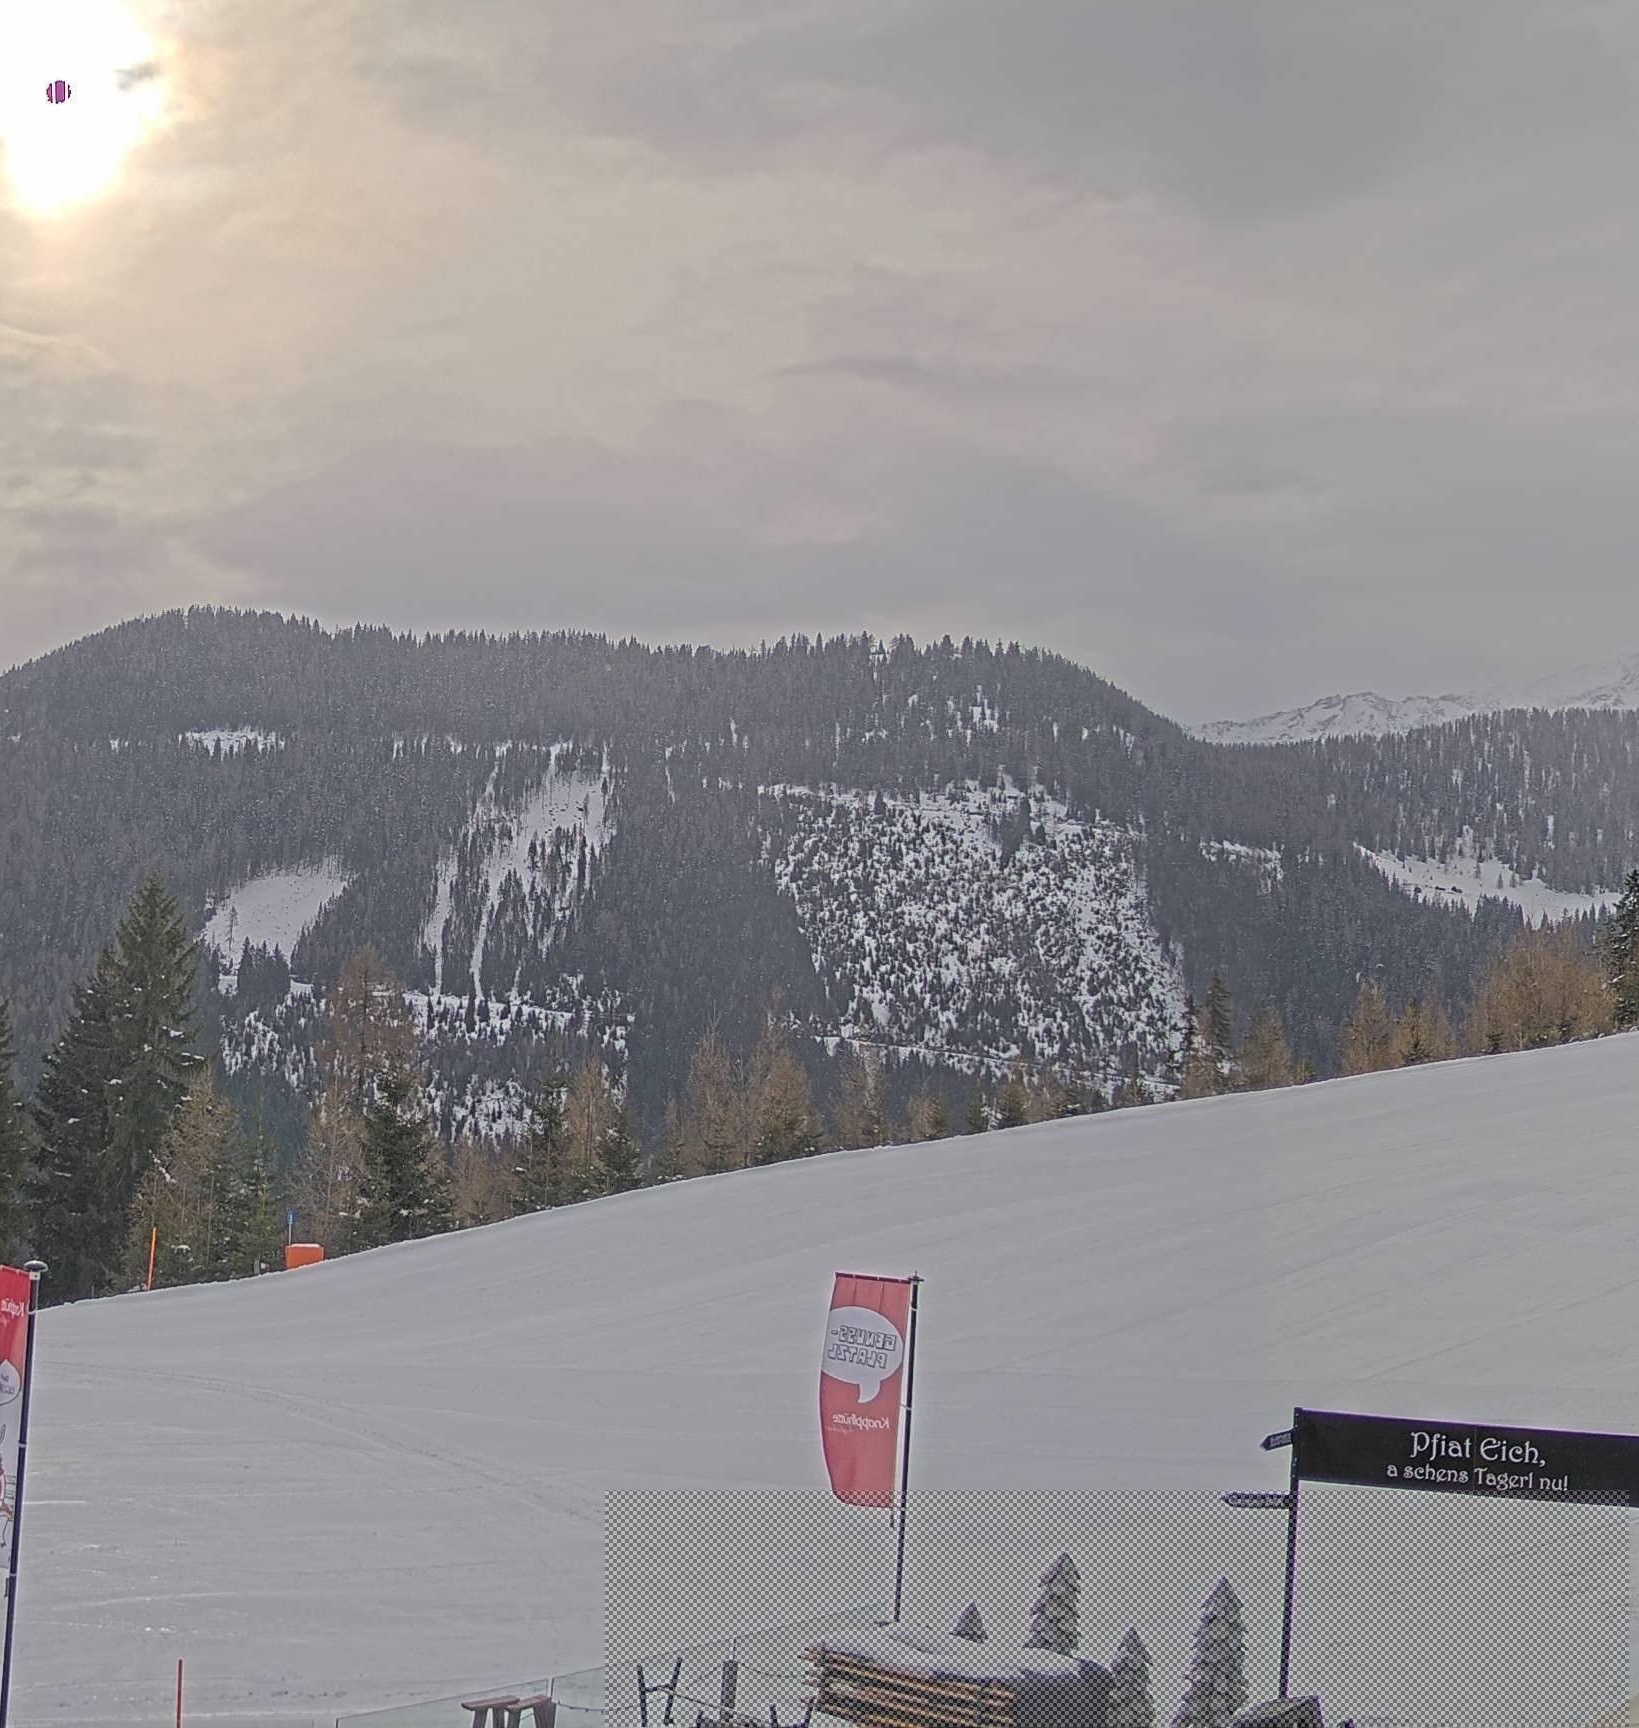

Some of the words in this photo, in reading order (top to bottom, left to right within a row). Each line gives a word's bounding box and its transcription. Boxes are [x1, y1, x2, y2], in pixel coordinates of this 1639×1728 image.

[1409, 1432, 1472, 1461] Pfiat
[1480, 1438, 1546, 1467] Eich,
[1387, 1464, 1398, 1478] a
[1403, 1463, 1469, 1483] schens
[1474, 1467, 1534, 1491] Tagerl
[1539, 1475, 1569, 1491] nu!
